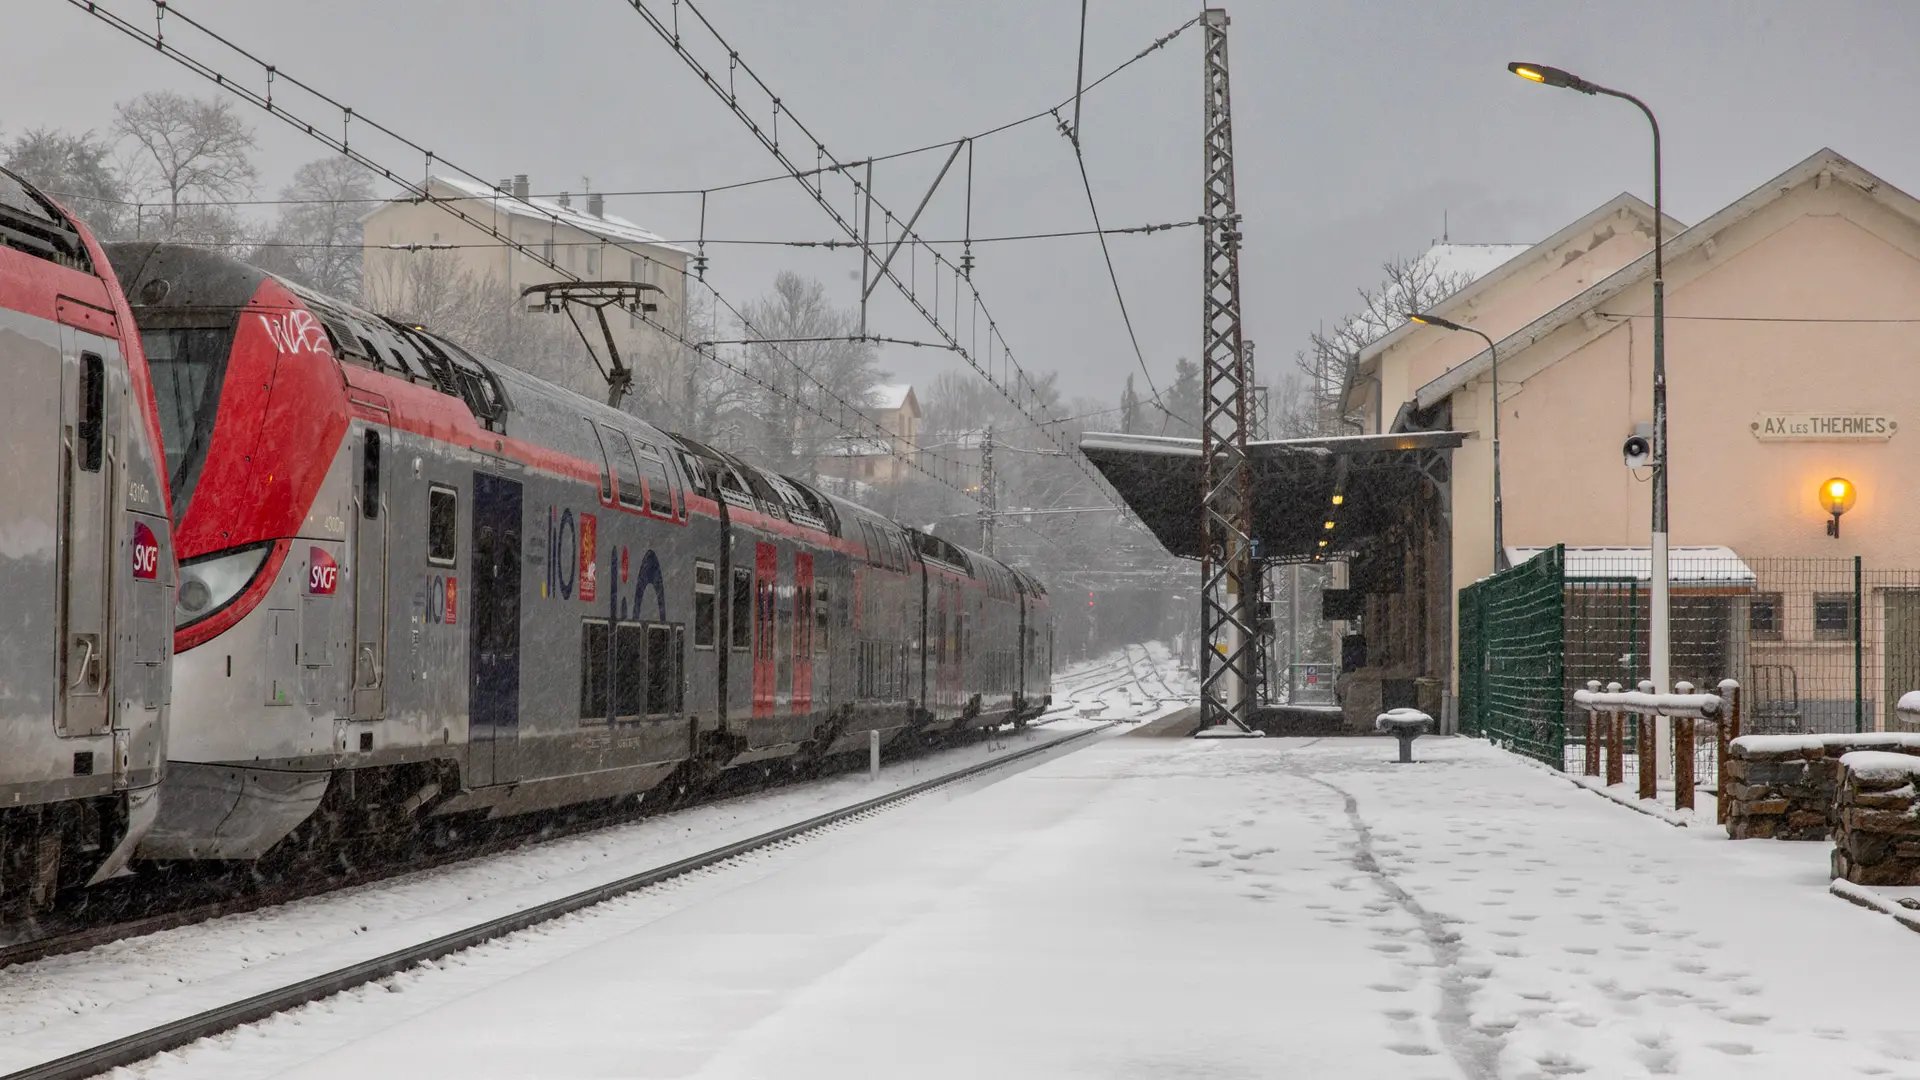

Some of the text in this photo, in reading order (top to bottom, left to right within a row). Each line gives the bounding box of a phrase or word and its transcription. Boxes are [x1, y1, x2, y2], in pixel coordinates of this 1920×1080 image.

[1764, 417, 1886, 434] AX LES THERMES
[133, 544, 158, 572] SNCF
[310, 565, 337, 589] SNCF
